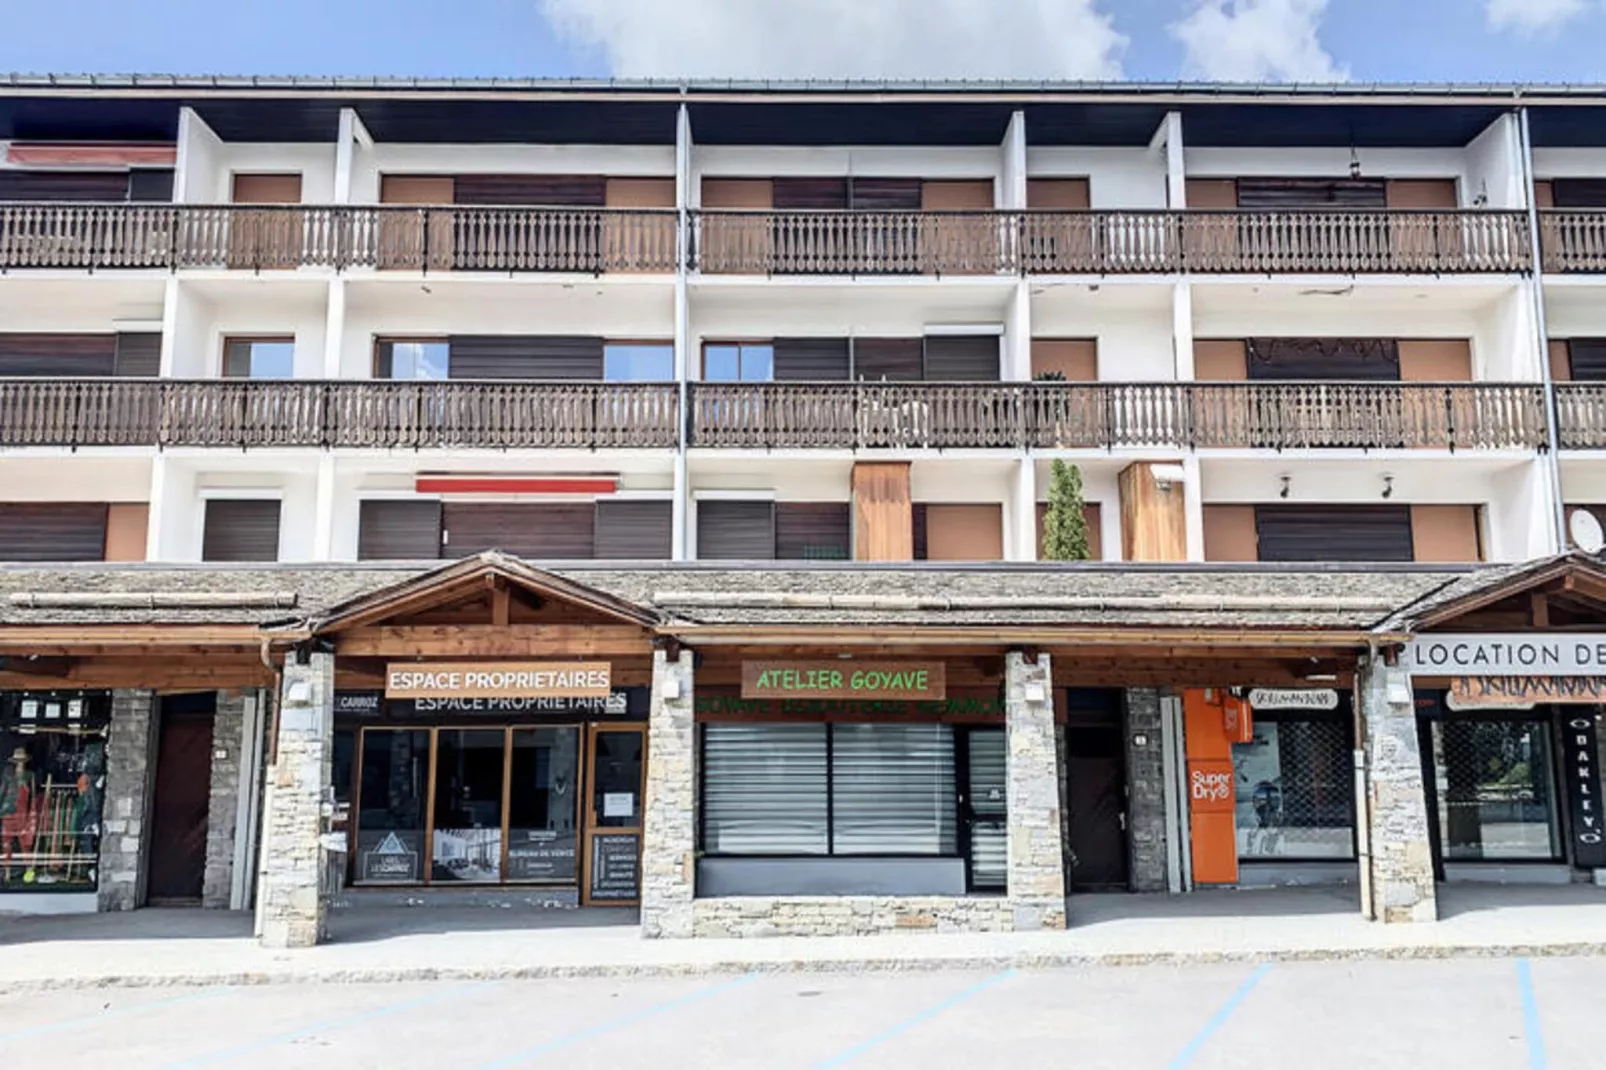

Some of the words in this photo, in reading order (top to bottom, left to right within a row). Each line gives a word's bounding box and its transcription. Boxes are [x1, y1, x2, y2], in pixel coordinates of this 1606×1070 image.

[1415, 643, 1560, 666] LOCATION
[388, 672, 462, 690] ESPACE
[464, 670, 611, 689] PROPRIETAIRES
[756, 669, 844, 690] ATELIER
[850, 670, 929, 690] GOYAVE
[414, 697, 482, 711] ESPACE
[1192, 770, 1231, 788] Super
